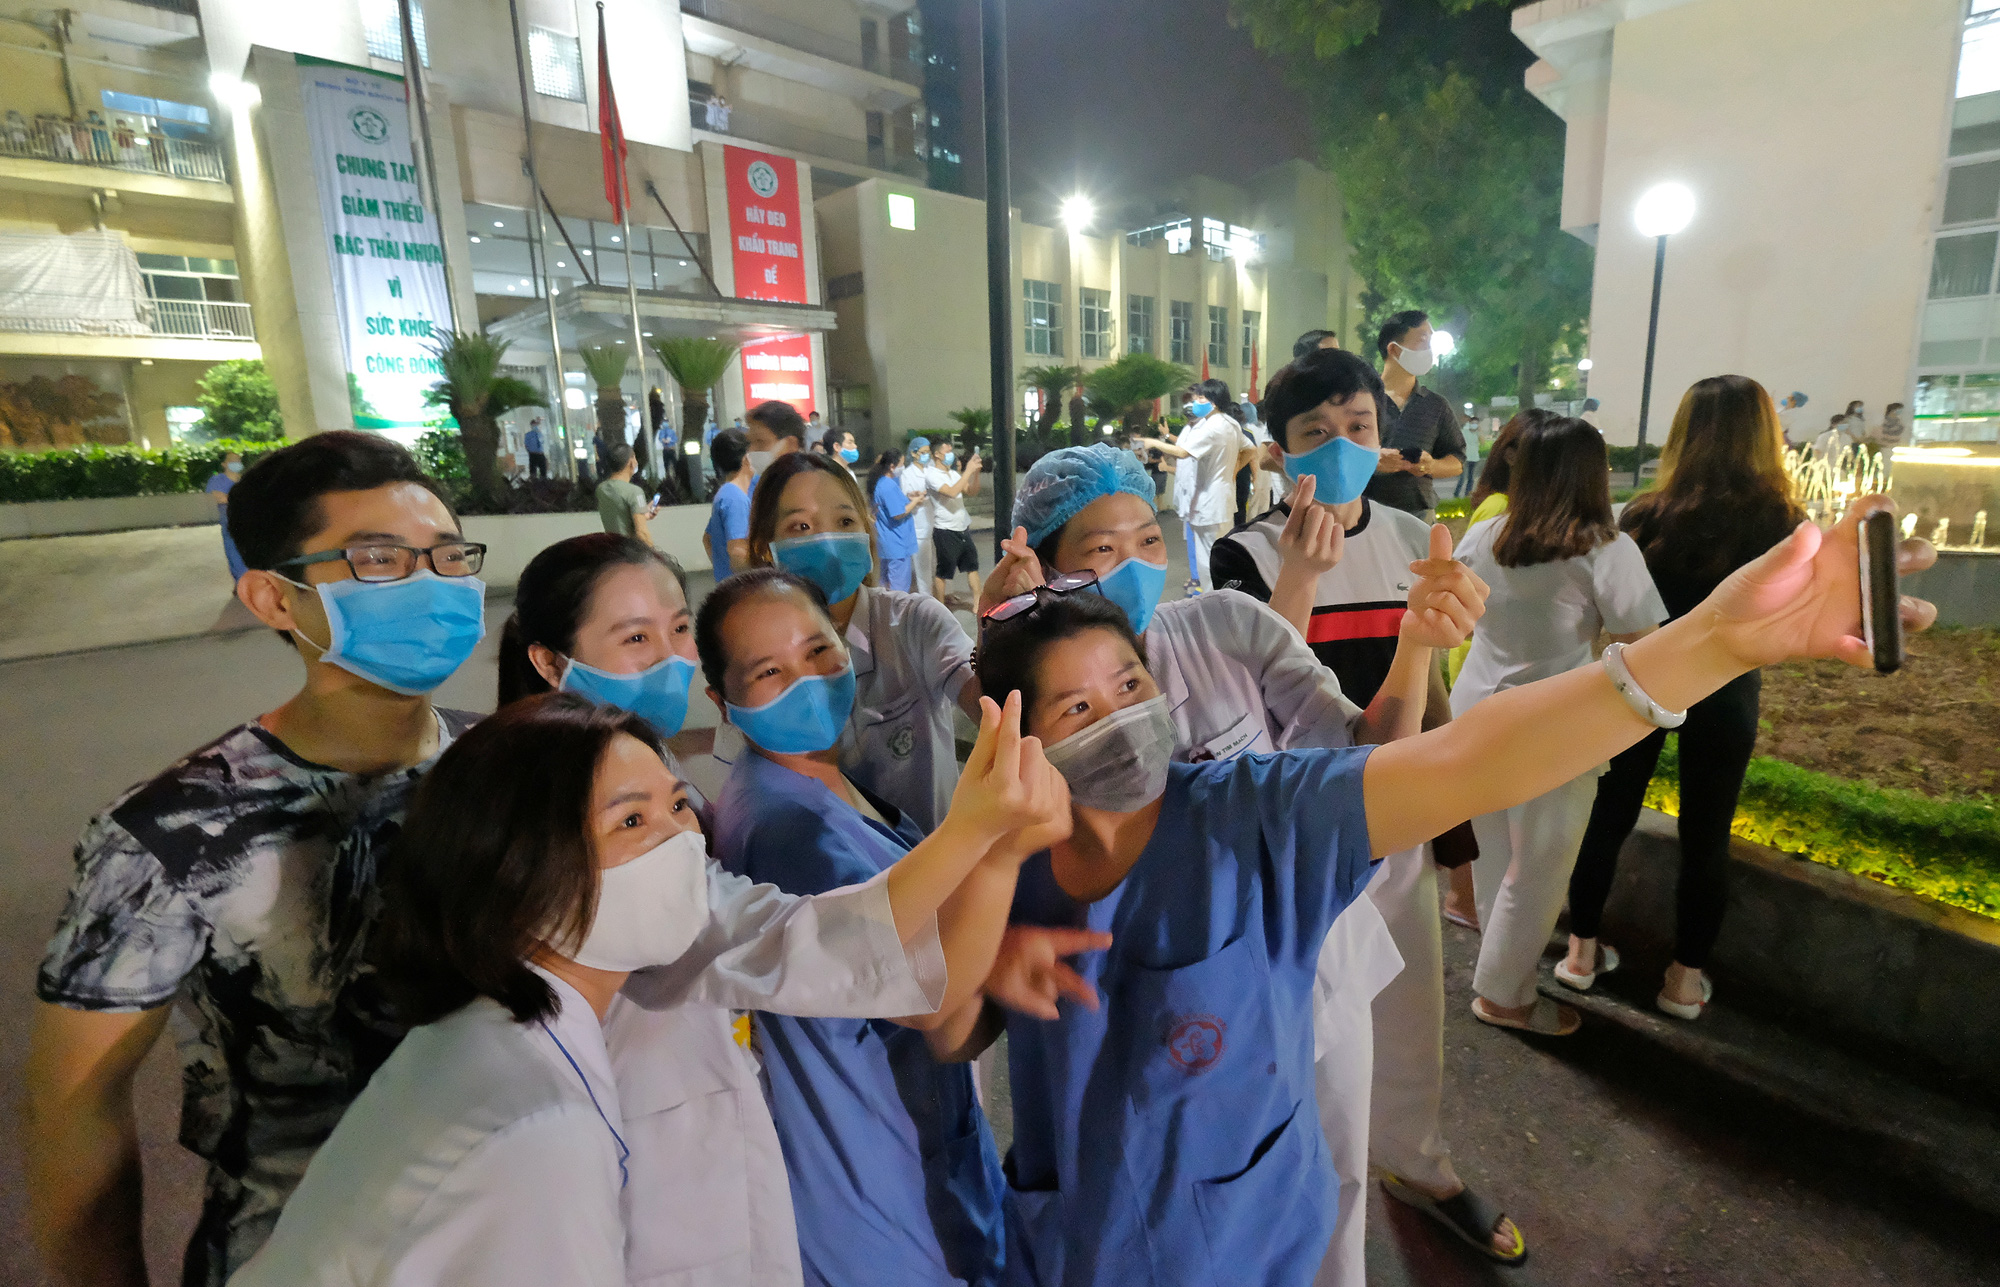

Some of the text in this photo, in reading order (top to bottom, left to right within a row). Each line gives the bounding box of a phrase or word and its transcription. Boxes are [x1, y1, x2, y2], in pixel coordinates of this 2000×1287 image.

[335, 153, 416, 184] CHUNG TAY
[341, 188, 424, 224] GIẢM THIỂU
[334, 231, 444, 267] RÁC THẢI NHỰA
[766, 240, 799, 258] TRANG
[387, 275, 403, 299] VÌ
[366, 312, 395, 336] SỨC
